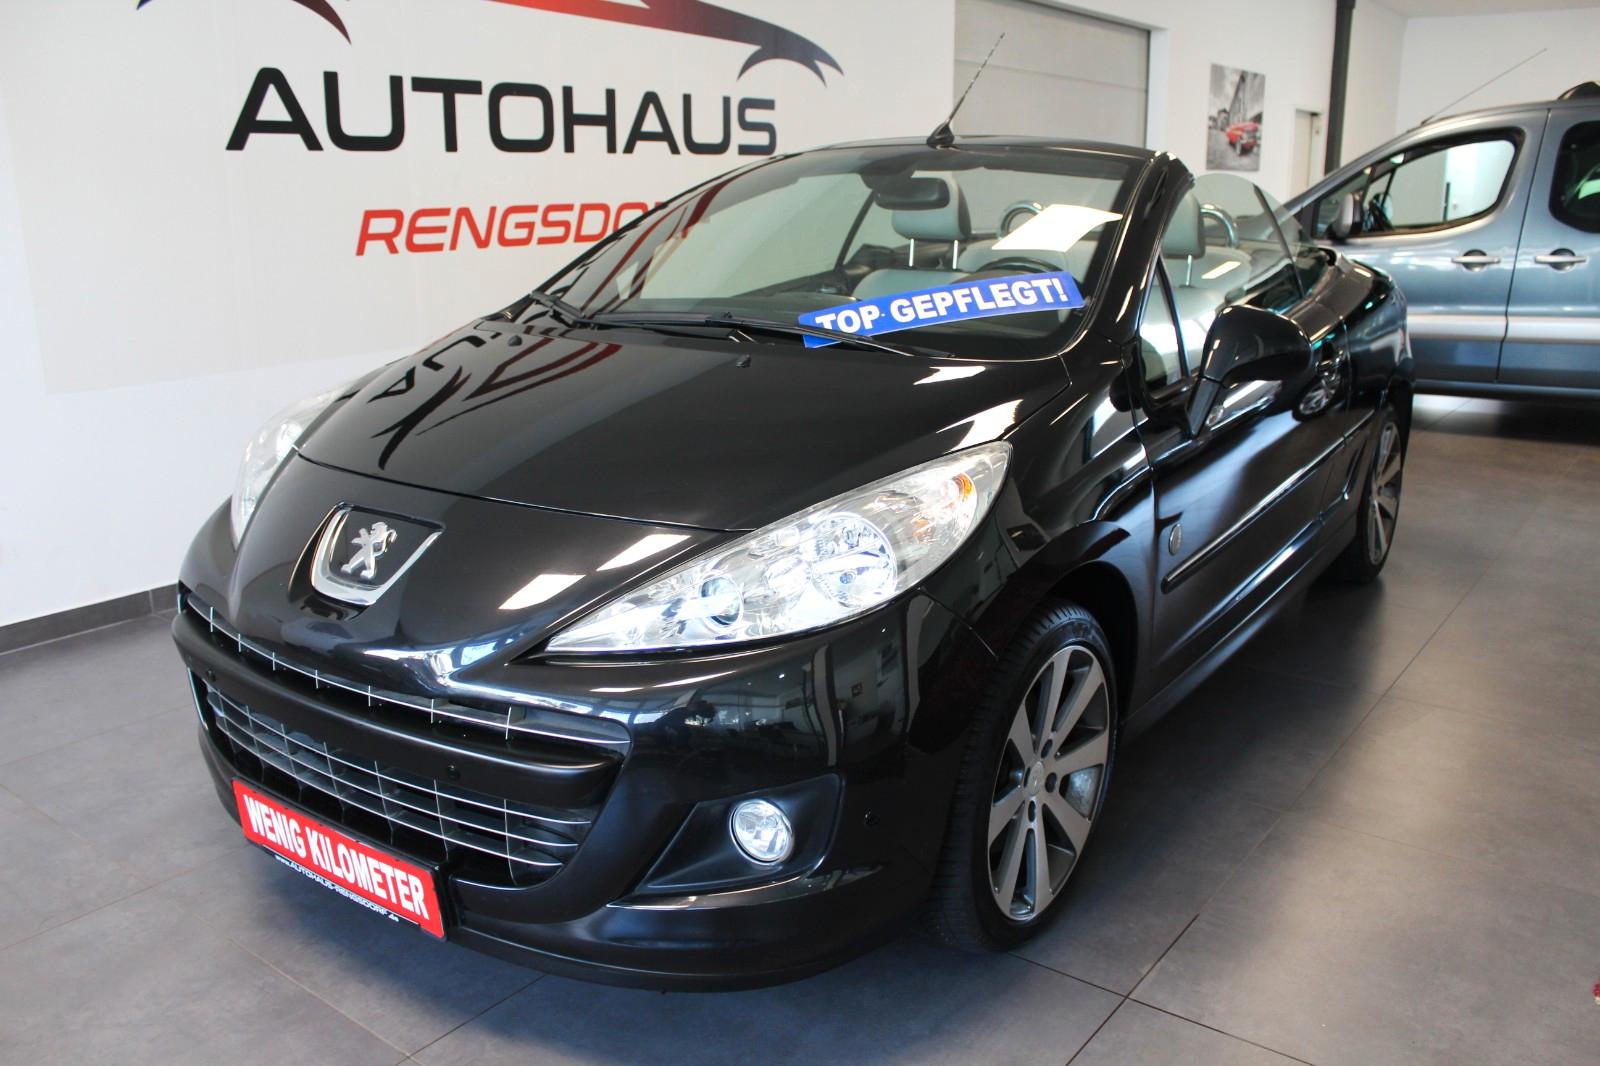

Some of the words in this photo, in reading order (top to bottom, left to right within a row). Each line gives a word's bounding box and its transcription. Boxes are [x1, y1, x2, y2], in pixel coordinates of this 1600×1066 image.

[225, 66, 778, 156] AUTOHAUS
[355, 201, 666, 257] RENGSDO
[815, 304, 882, 334] TOP
[889, 277, 1069, 323] GEPFLEGT!
[243, 793, 307, 859] WENIG
[305, 826, 430, 920] KILOMETER
